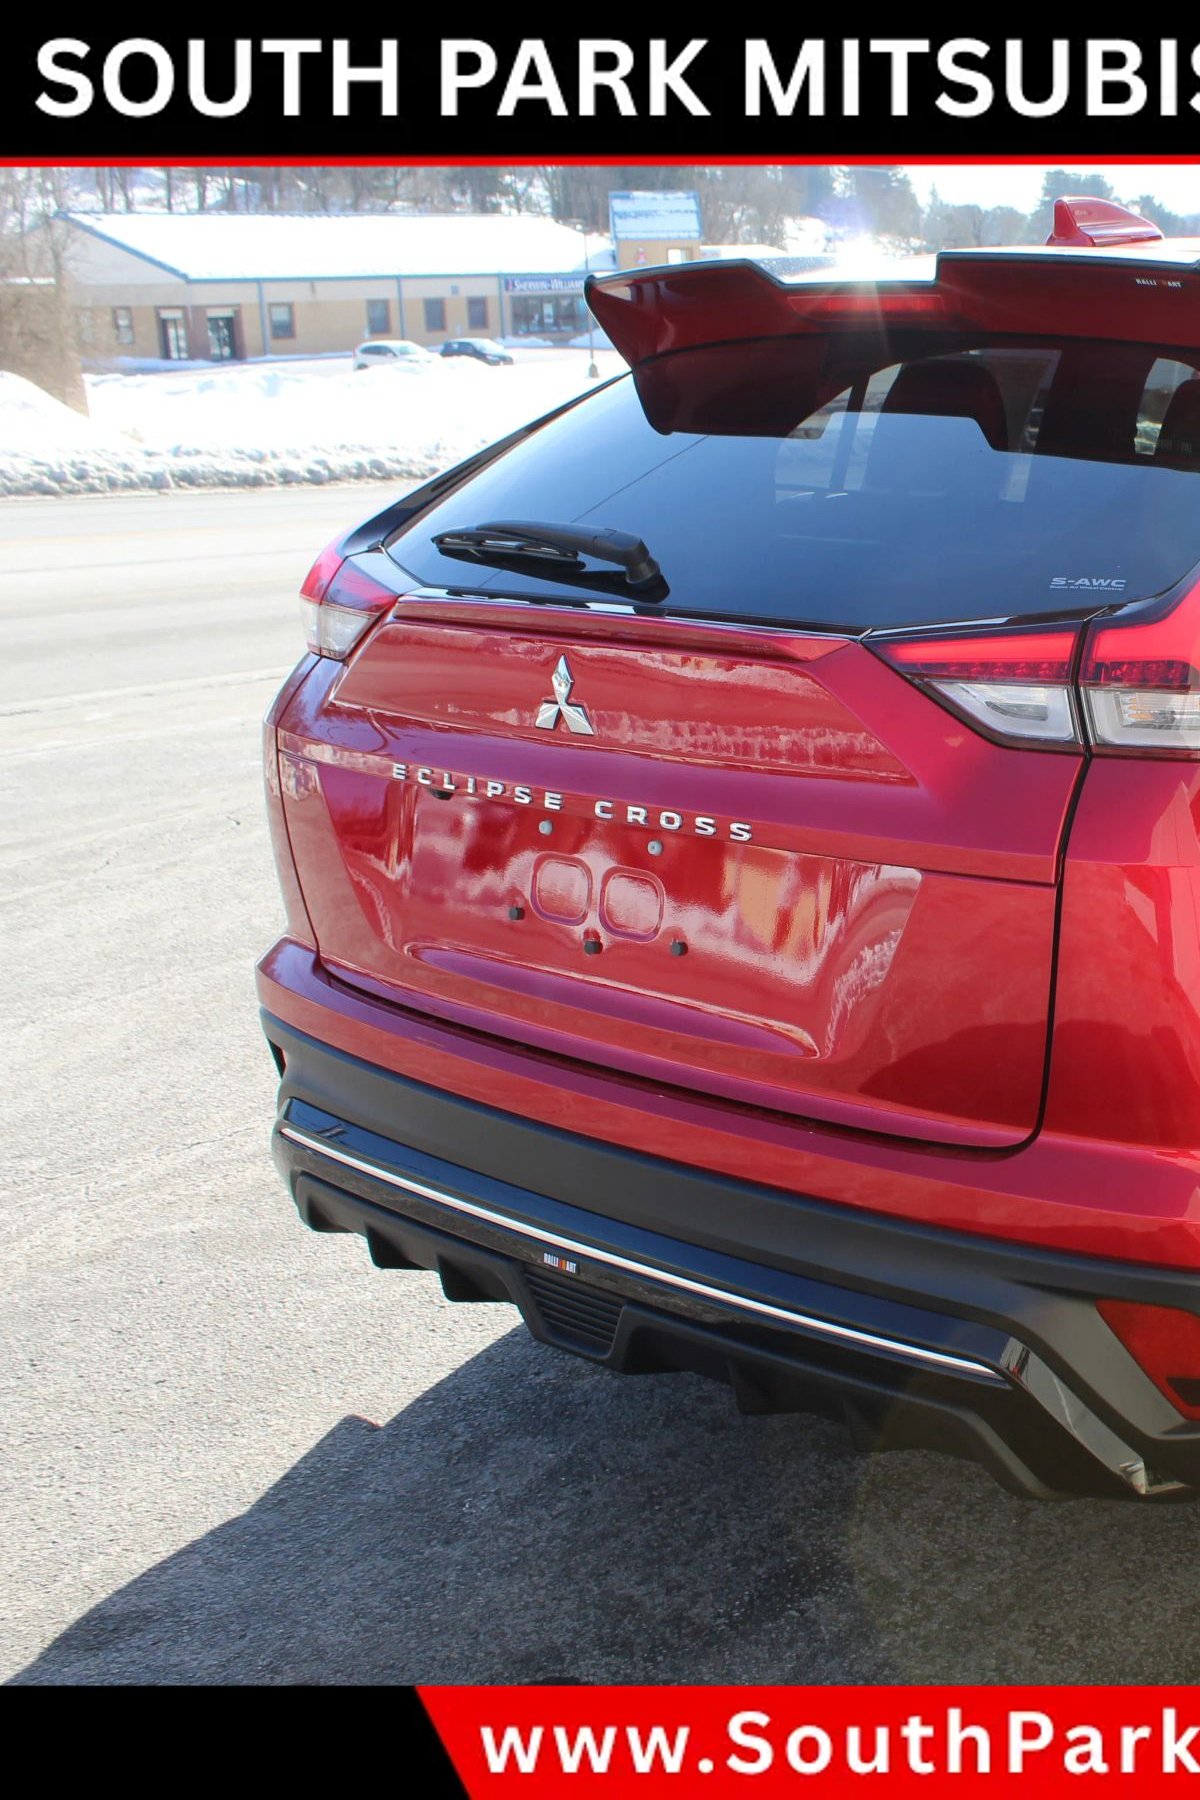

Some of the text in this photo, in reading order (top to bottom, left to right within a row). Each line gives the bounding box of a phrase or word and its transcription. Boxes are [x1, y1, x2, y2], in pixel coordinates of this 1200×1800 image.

[1050, 577, 1127, 588] S-AWC
[391, 762, 752, 842] ECLIPSE CROSS
